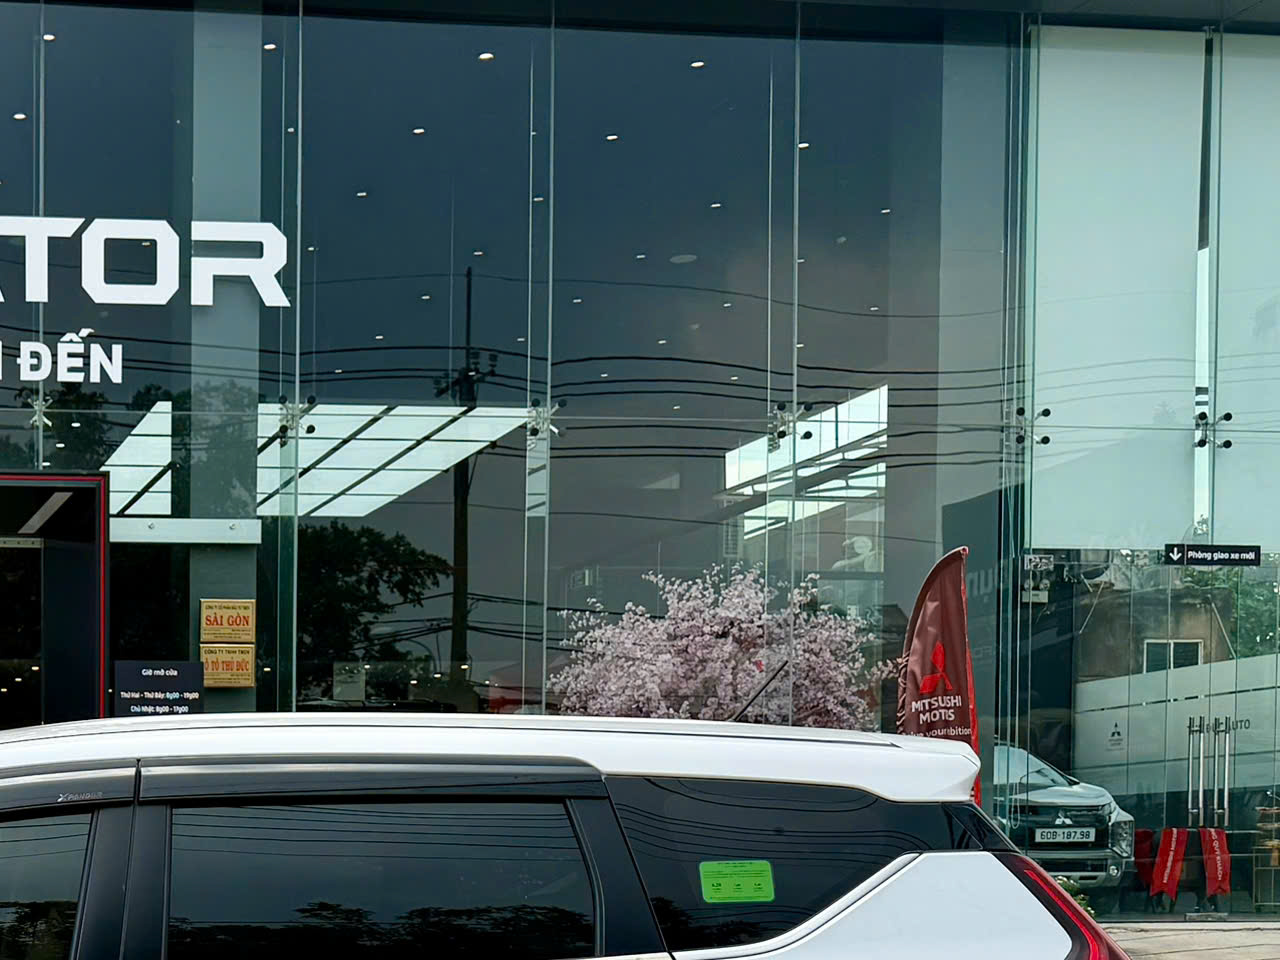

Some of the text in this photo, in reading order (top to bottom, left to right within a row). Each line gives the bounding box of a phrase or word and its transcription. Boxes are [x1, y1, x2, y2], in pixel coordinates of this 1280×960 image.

[16, 328, 125, 384] ĐẾN
[1187, 551, 1212, 560] Phòng
[1213, 551, 1230, 560] giao
[227, 612, 250, 626] GÒN
